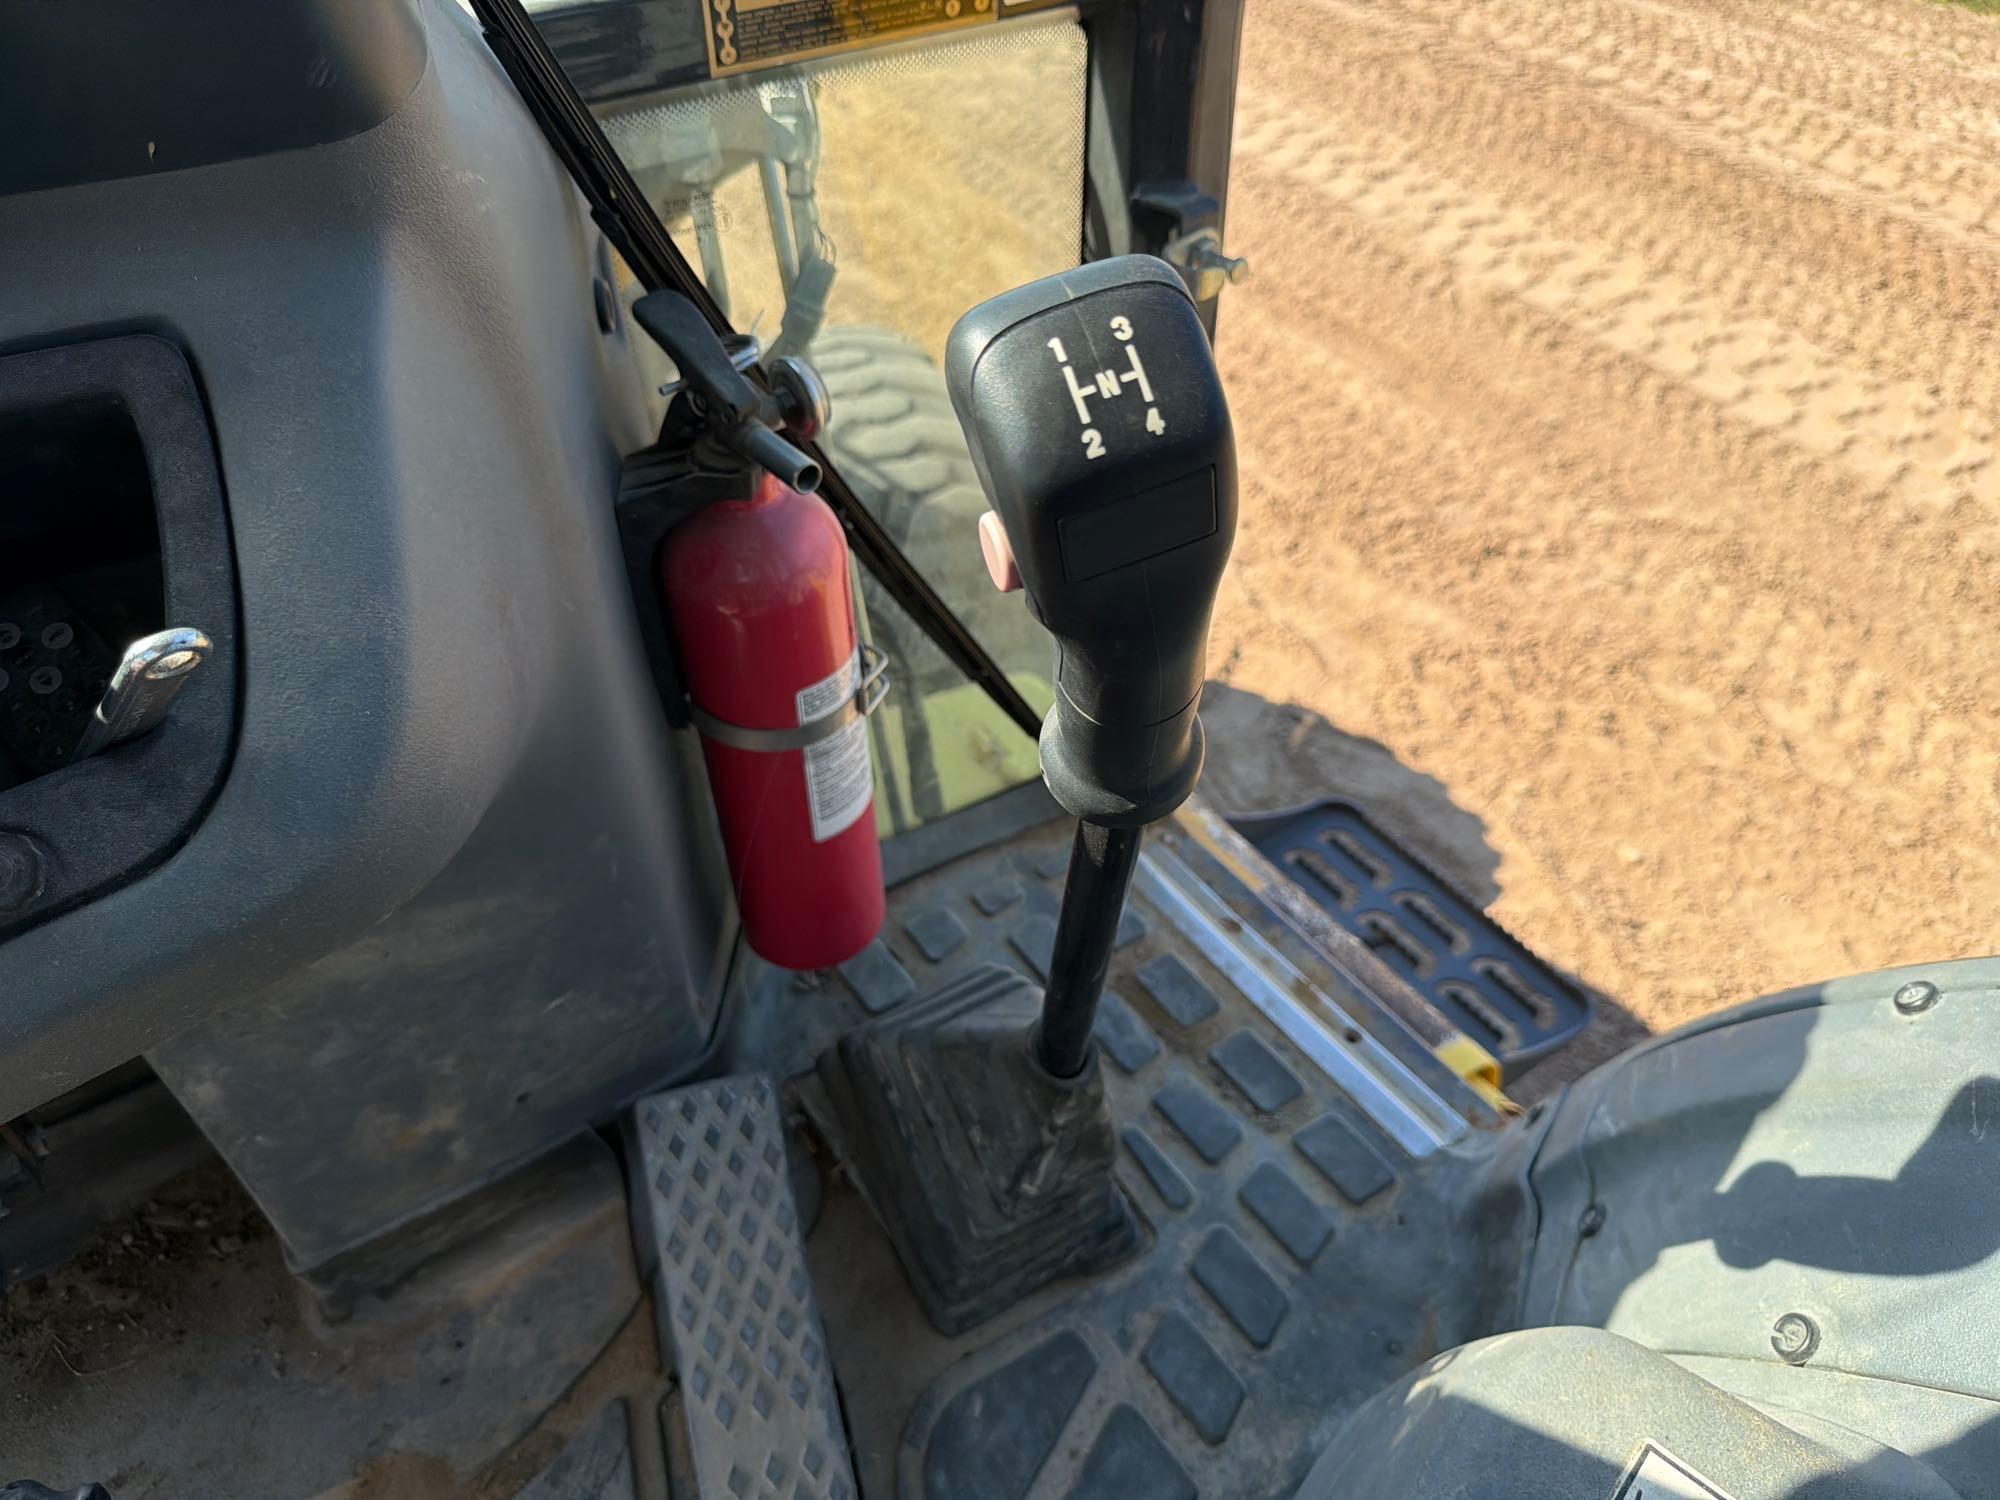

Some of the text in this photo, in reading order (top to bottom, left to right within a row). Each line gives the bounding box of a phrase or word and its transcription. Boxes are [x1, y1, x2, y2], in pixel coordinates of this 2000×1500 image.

[1110, 315, 1134, 341] 3
[1047, 337, 1067, 363] 1
[1095, 369, 1122, 399] N
[1146, 407, 1167, 436] 4
[1081, 428, 1106, 460] 2
